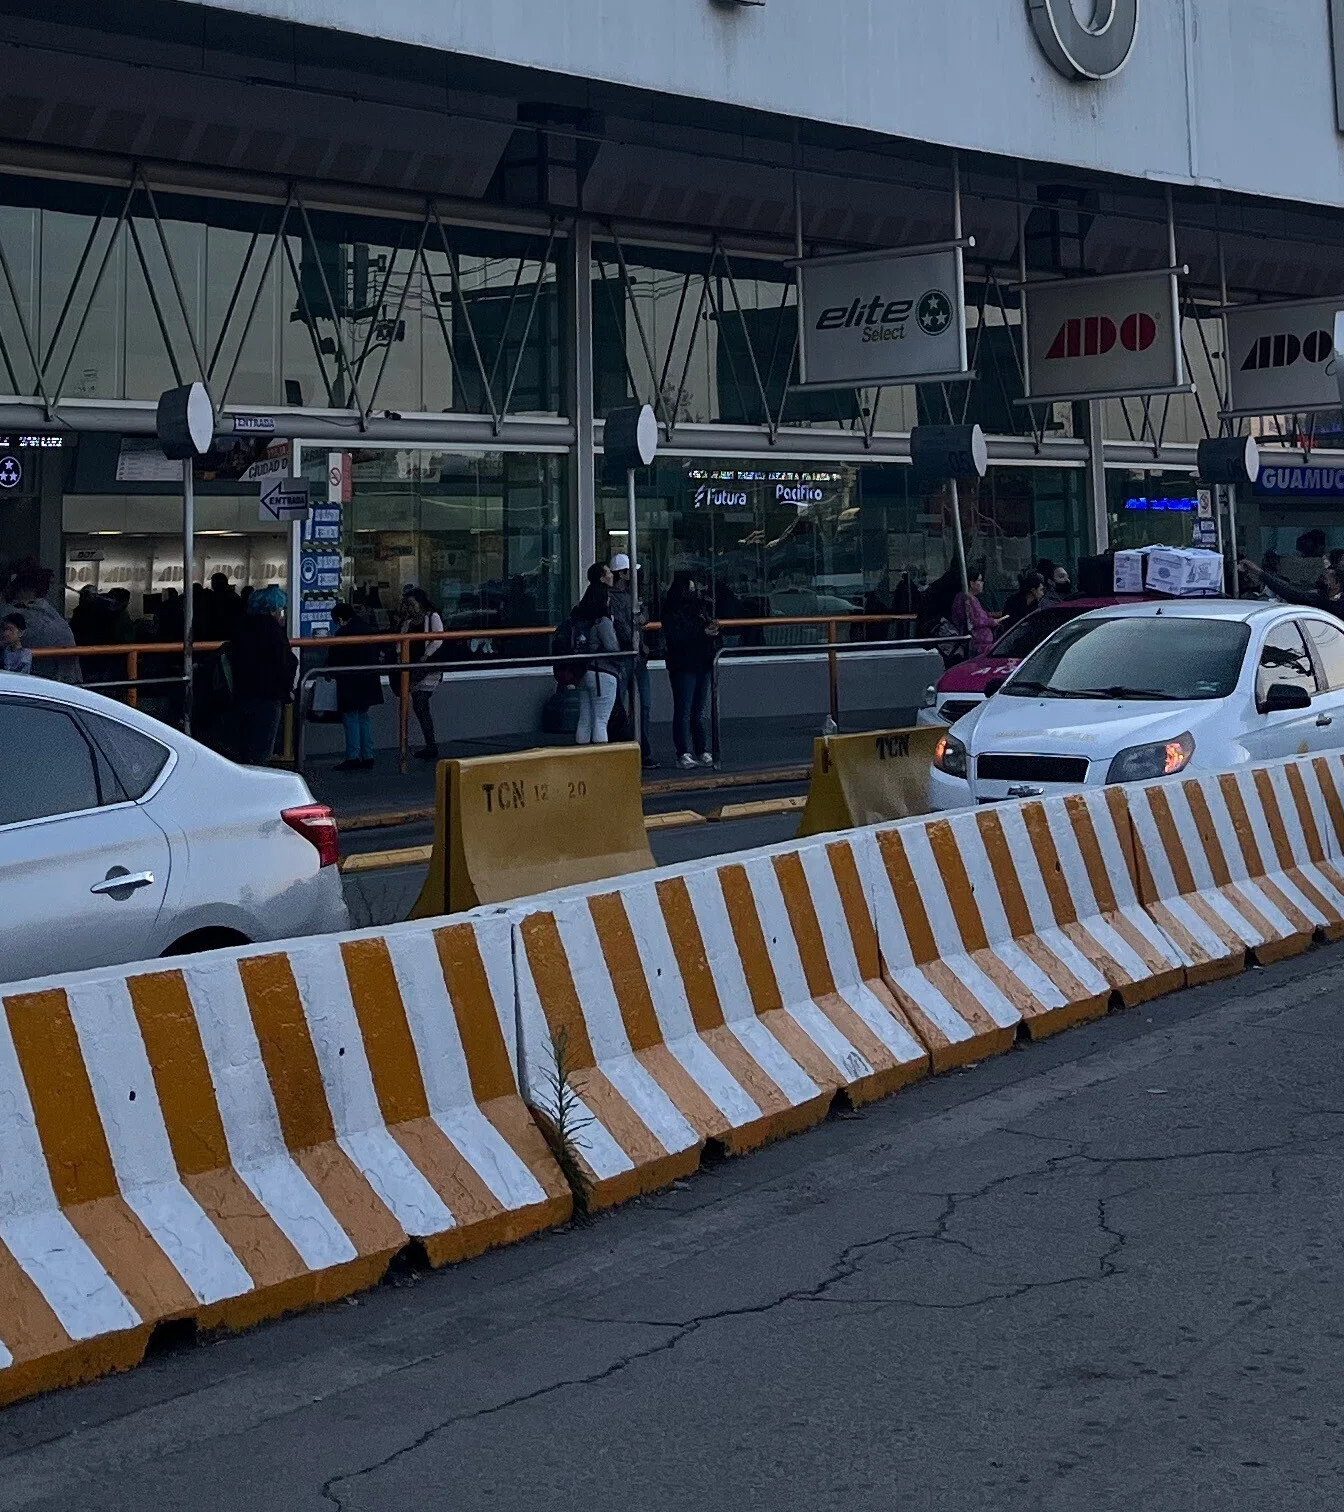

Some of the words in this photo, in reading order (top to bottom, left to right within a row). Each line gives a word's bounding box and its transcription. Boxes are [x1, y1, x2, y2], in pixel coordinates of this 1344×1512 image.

[815, 295, 914, 330] elite
[861, 324, 906, 343] Select
[1044, 312, 1156, 360] ADO
[1239, 330, 1333, 371] ADO
[236, 417, 275, 428] ENTRADA
[248, 459, 280, 479] CIUDAD
[269, 496, 305, 505] ENTRADA
[706, 488, 747, 506] Futura
[876, 733, 910, 760] TCN
[482, 779, 525, 812] TCN
[567, 780, 587, 799] 20
